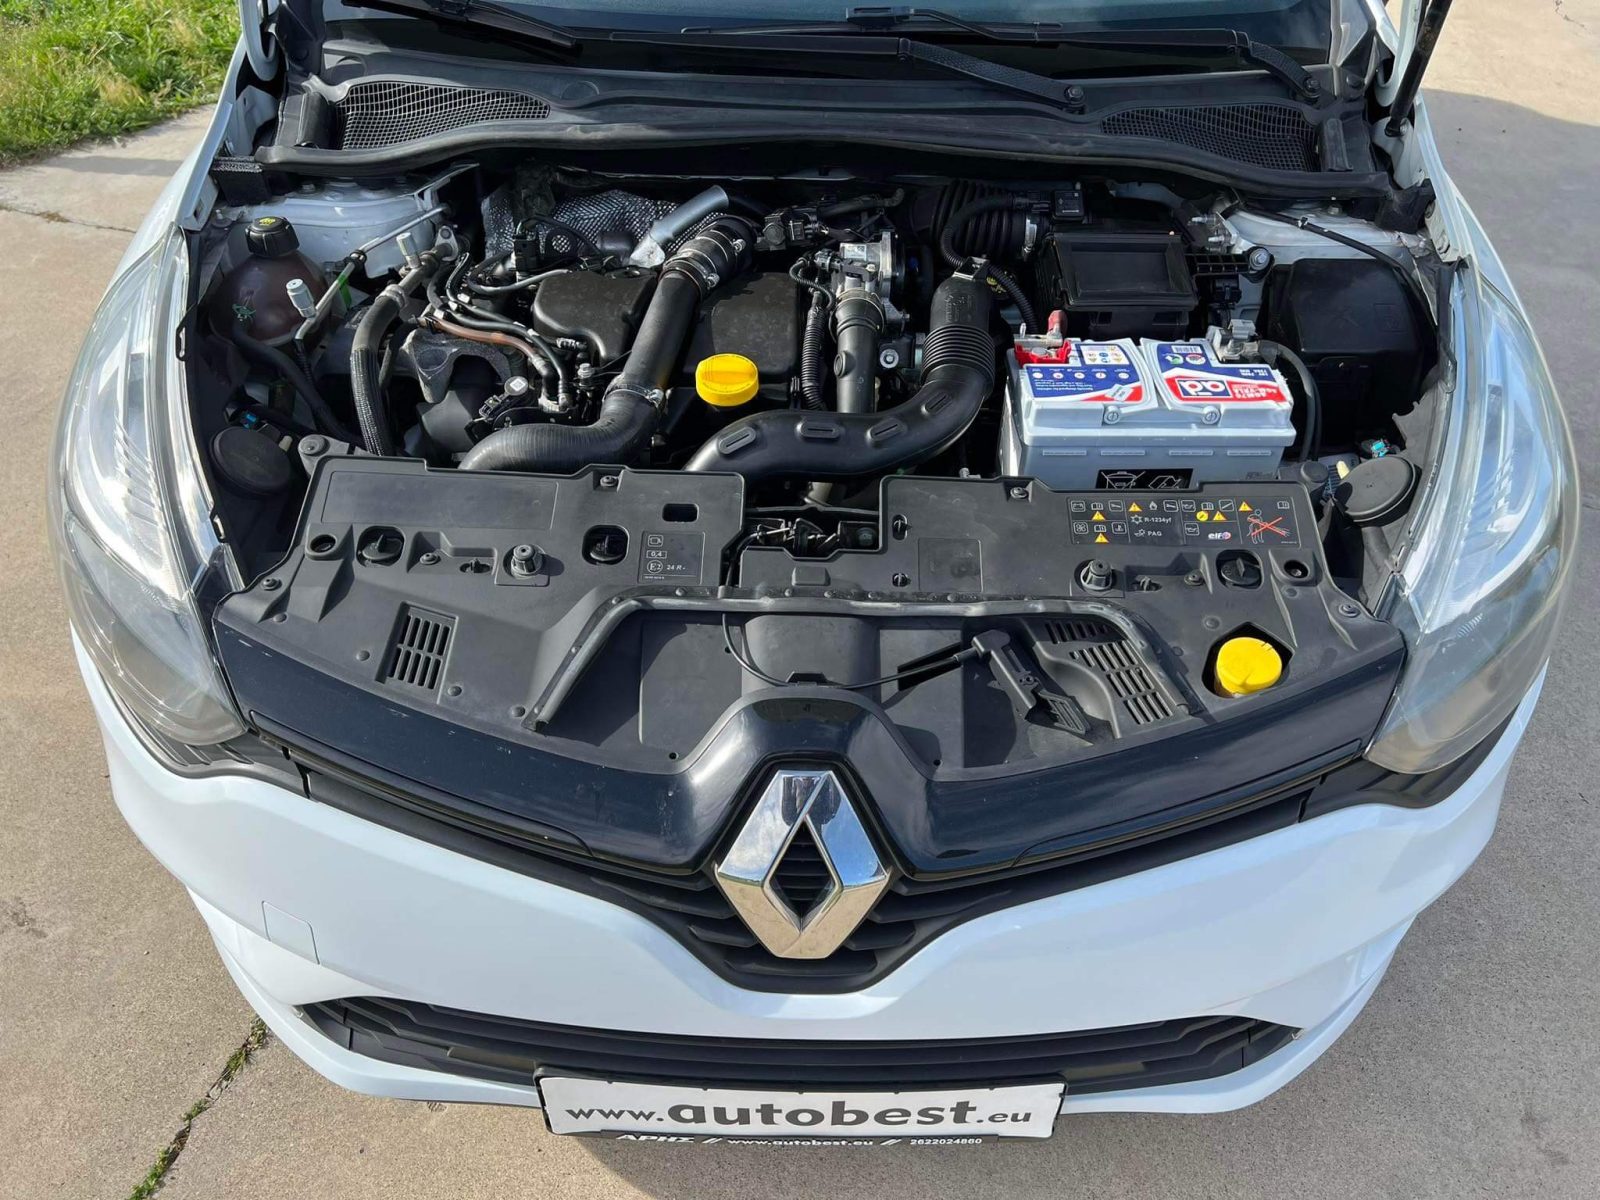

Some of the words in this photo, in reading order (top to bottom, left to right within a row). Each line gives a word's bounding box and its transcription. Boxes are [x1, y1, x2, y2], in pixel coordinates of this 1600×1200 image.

[1144, 516, 1172, 524] R-1234yf
[1208, 532, 1222, 540] elf
[565, 1100, 1032, 1127] www.autobest.eu
